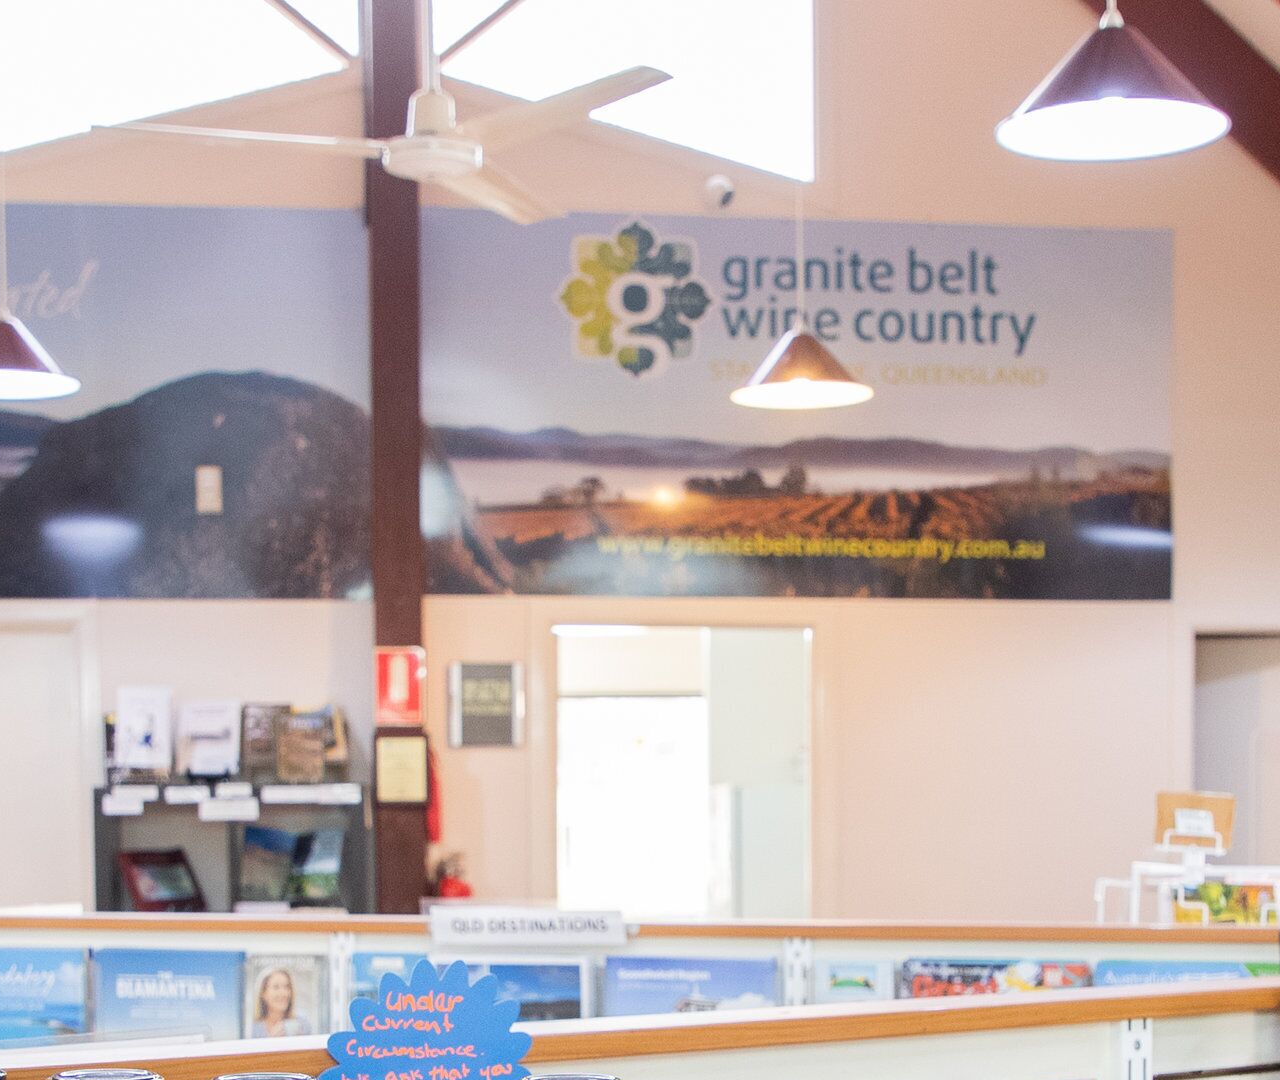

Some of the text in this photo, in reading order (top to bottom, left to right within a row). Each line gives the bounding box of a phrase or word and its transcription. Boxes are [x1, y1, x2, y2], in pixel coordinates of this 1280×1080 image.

[722, 247, 999, 301] granite belt
[723, 297, 1036, 356] wine country
[597, 531, 1046, 563] www.granitebeltwinecountry.com.au
[452, 917, 608, 934] QLD DESTINATIONS
[116, 976, 216, 999] DIAMANTINA
[480, 1063, 512, 1080] you
